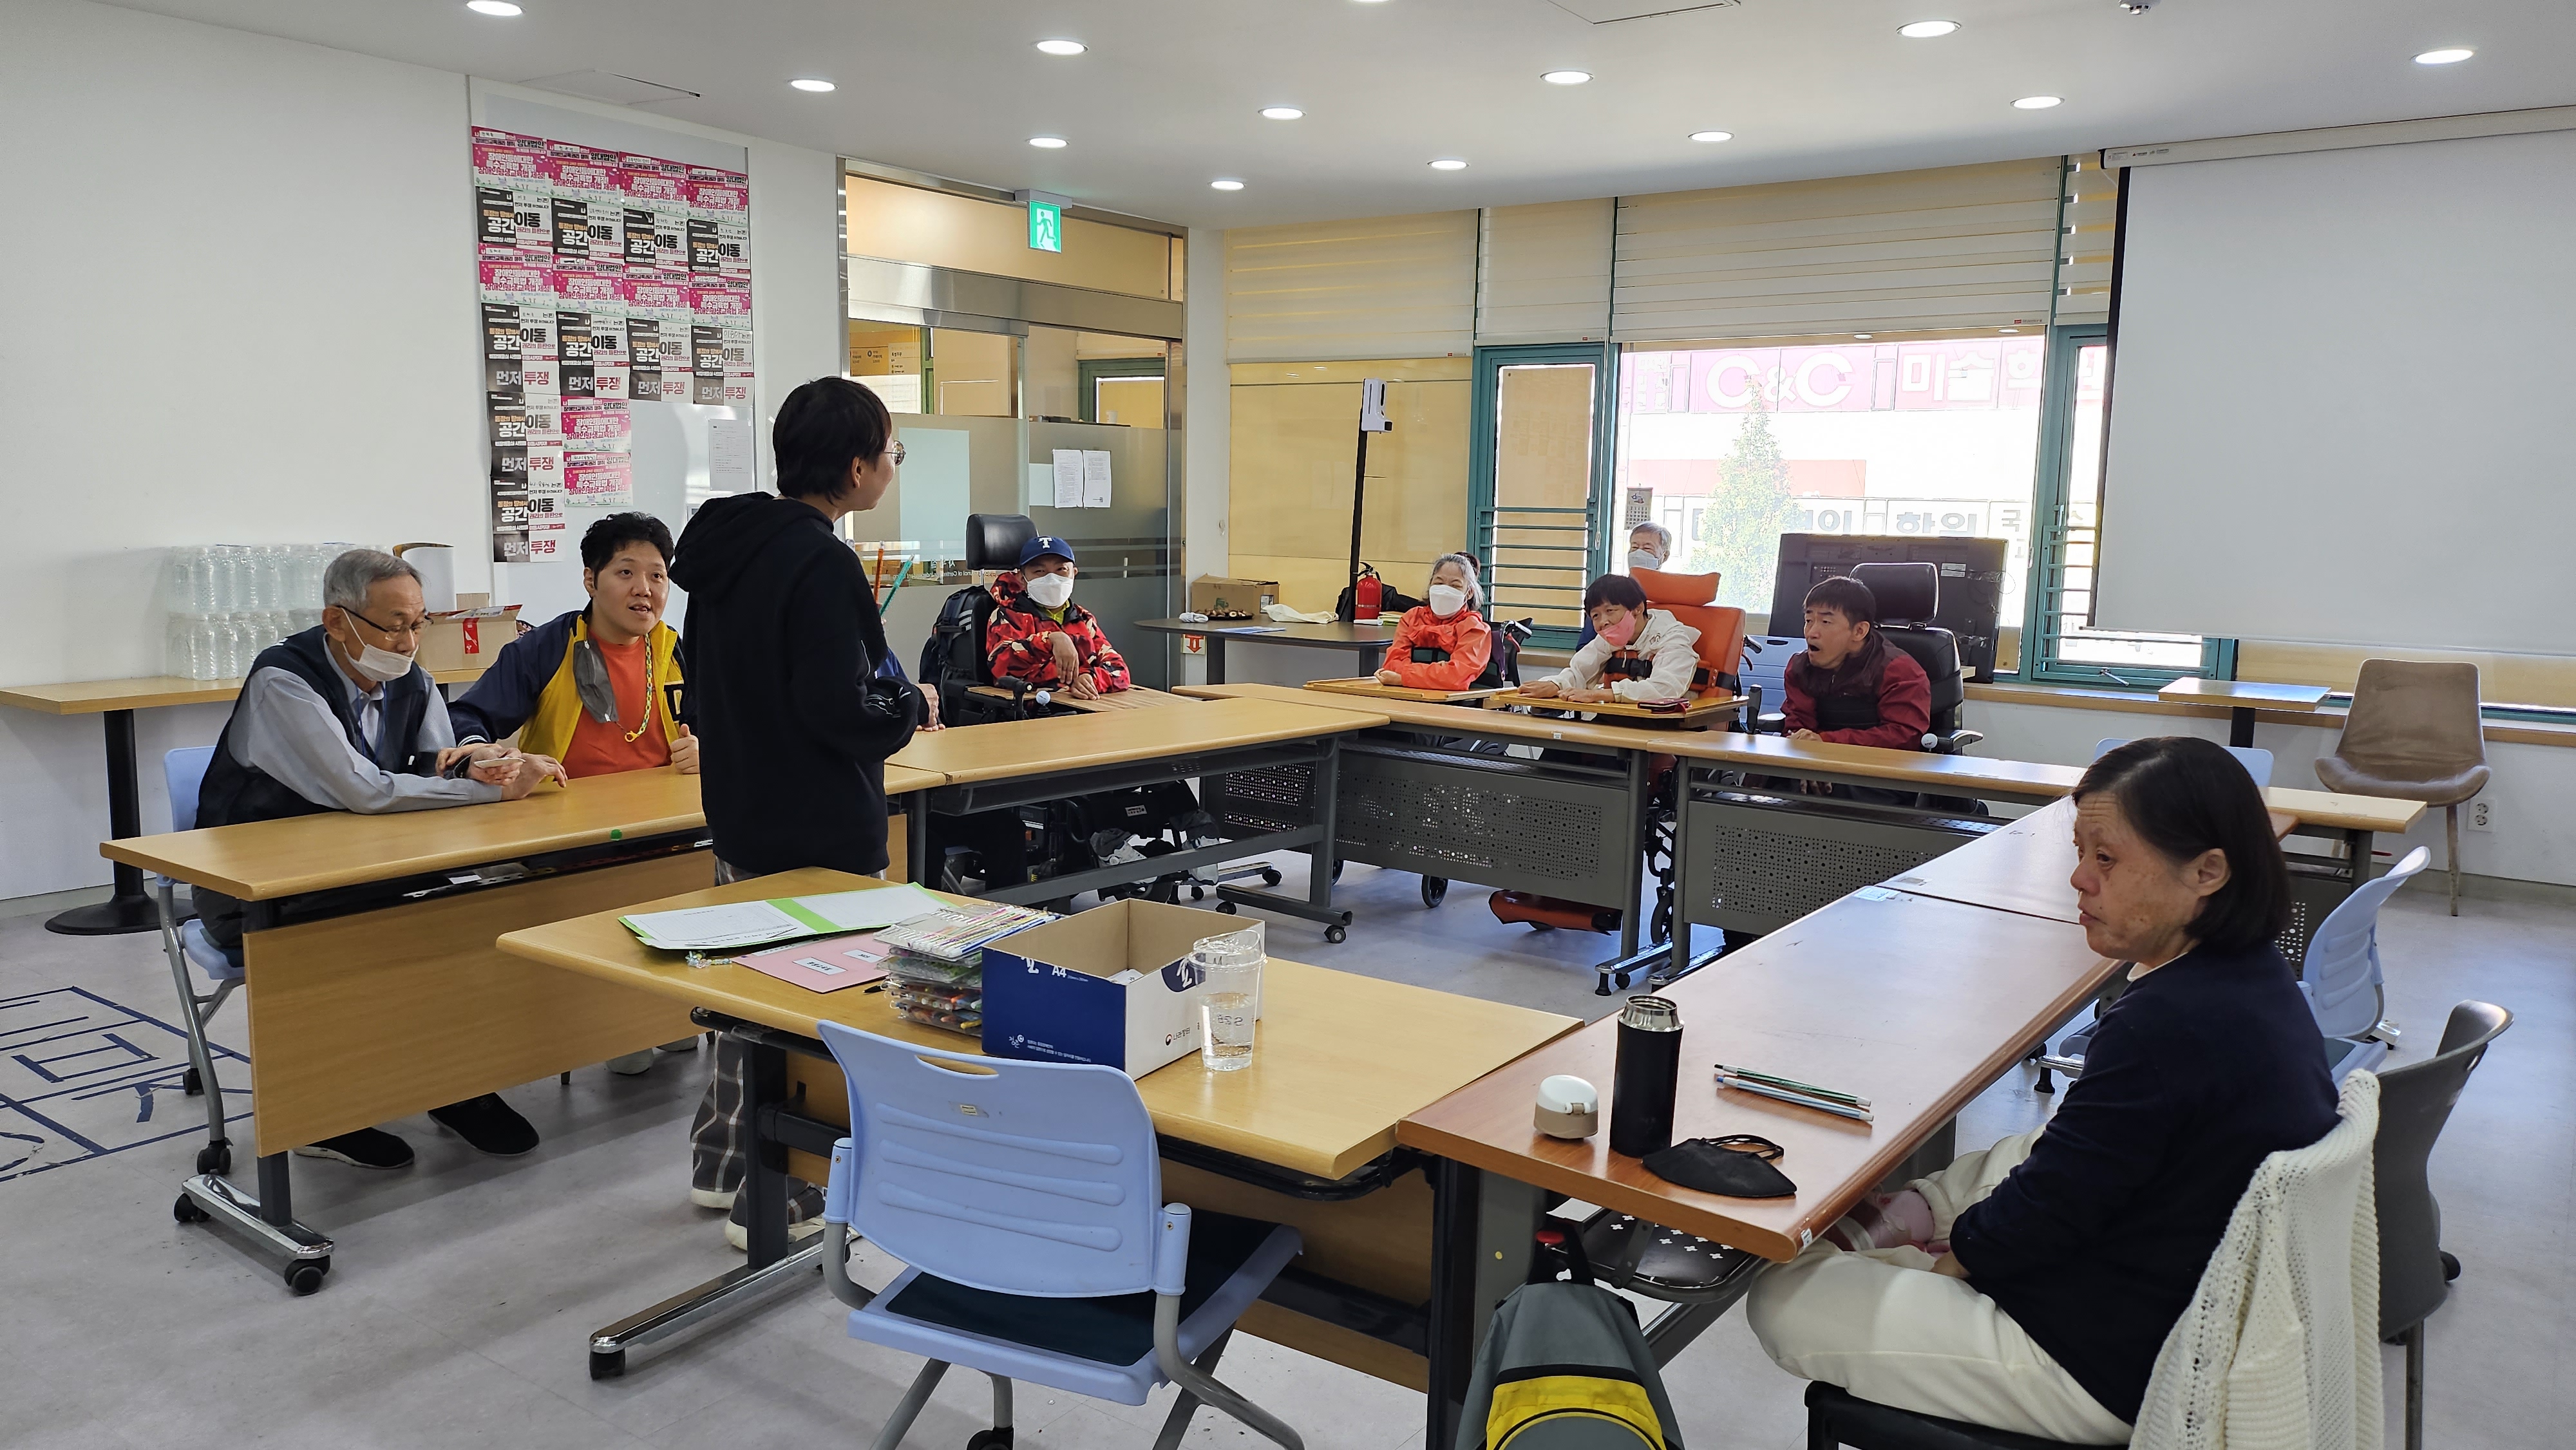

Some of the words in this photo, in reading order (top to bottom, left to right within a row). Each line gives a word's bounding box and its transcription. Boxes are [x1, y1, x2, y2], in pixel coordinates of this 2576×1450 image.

[487, 216, 515, 234] 공간
[514, 211, 540, 228] 이동
[562, 229, 588, 246] 공간
[588, 224, 612, 240] 이동
[630, 238, 655, 255] 공간
[654, 234, 677, 249] 이동
[696, 248, 719, 263] 공간
[719, 243, 741, 257] 이동
[493, 335, 520, 350] 공간
[520, 328, 546, 343] 이동
[592, 335, 617, 349] 이동
[565, 342, 592, 357] 공간
[636, 348, 659, 362] 공간
[659, 341, 682, 355] 이동
[723, 348, 744, 361] 이동
[699, 354, 723, 368] 공간
[497, 371, 522, 385] 먼저
[524, 372, 549, 385] 투쟁
[569, 376, 594, 391] 먼저
[596, 376, 621, 390] 투쟁
[1707, 352, 1854, 408] C&C
[638, 380, 660, 395] 먼저
[662, 381, 685, 395] 투쟁
[702, 386, 723, 400] 먼저
[724, 386, 746, 399] 투쟁
[526, 414, 551, 428] 이동
[498, 422, 526, 437] 공간
[502, 457, 526, 472] 먼저
[529, 456, 554, 471] 투쟁
[528, 498, 554, 512] 이동
[501, 506, 528, 522] 공간
[504, 541, 529, 556] 먼저
[531, 540, 556, 554] 투쟁
[1038, 537, 1052, 549] T
[1052, 966, 1066, 977] A4
